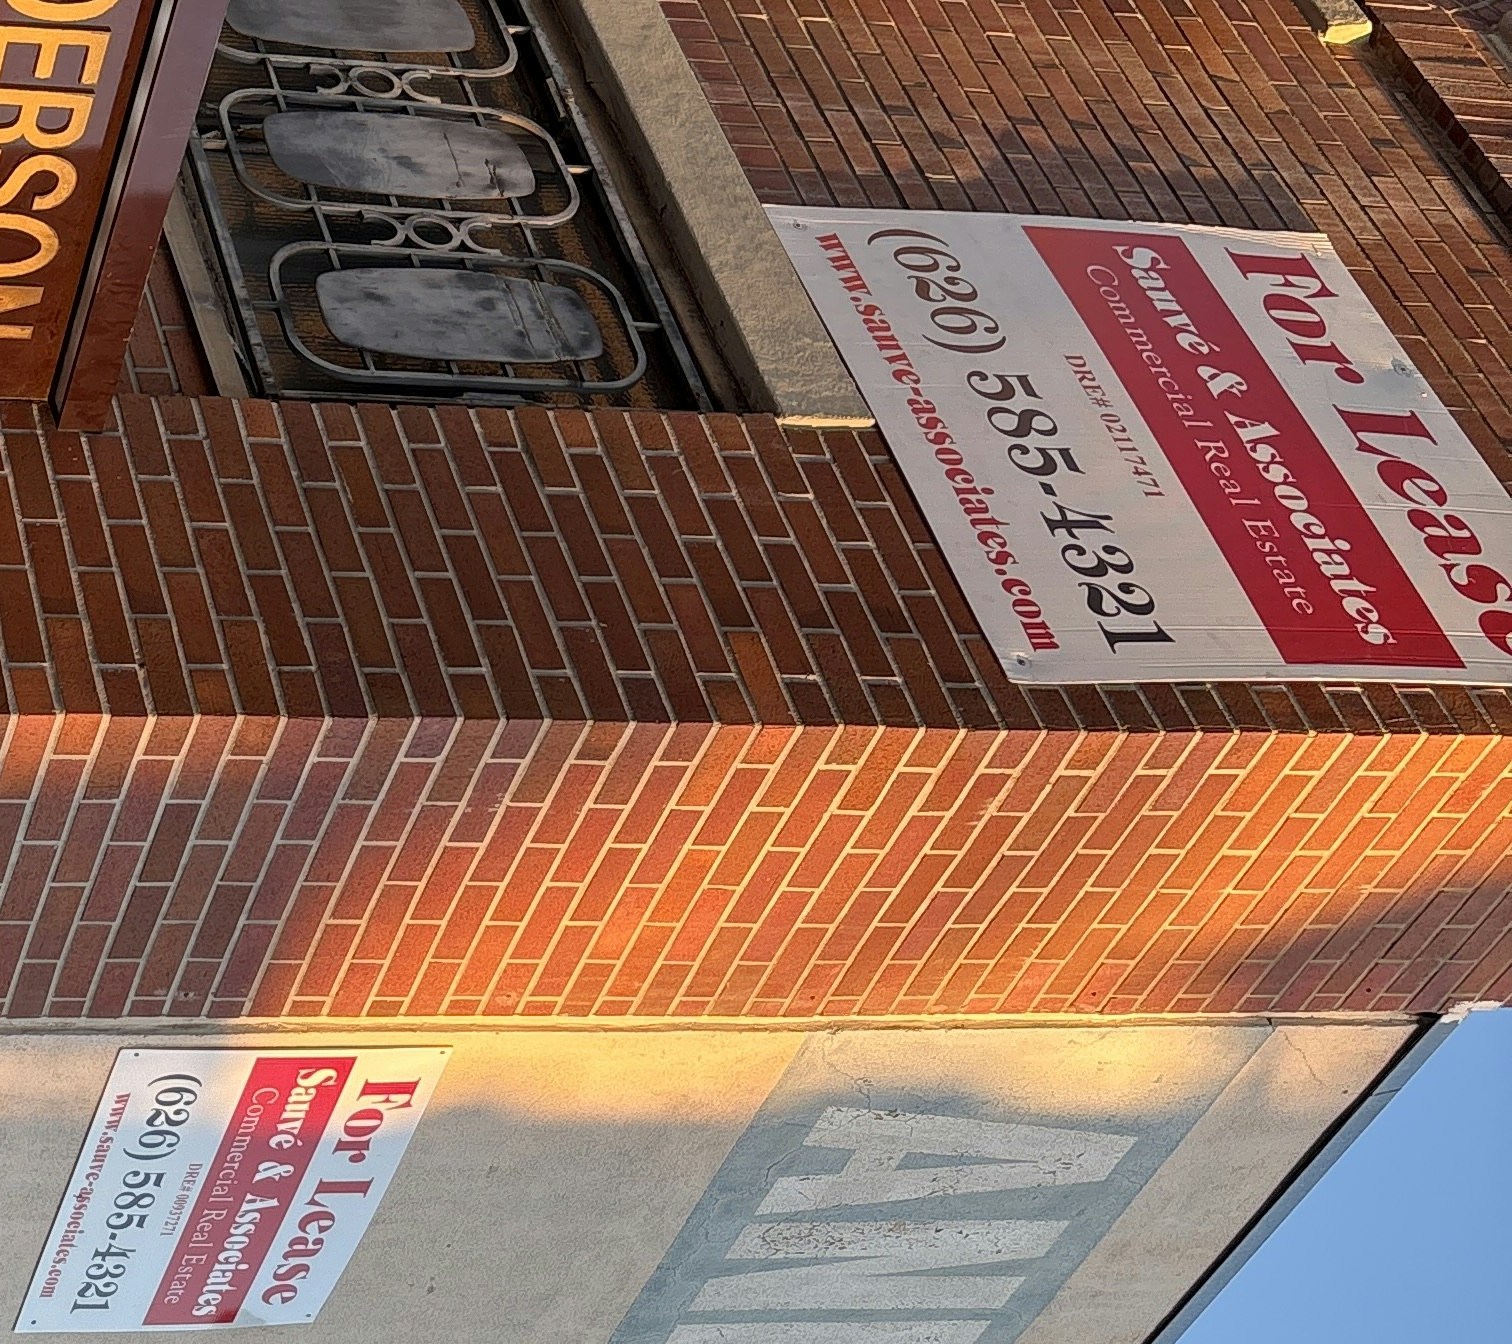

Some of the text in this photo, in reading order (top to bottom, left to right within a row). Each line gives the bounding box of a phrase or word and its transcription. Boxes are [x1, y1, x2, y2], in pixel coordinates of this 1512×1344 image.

[1064, 354, 1165, 500] DRE# 02117471
[1225, 247, 1365, 383] For
[814, 232, 1060, 652] www.sauve-associates.com
[866, 226, 1175, 655] (626) 585-4321
[1086, 265, 1317, 616] Commercial Real Estate
[1111, 244, 1399, 646] Sauvé & Associates
[39, 1093, 131, 1299] www.sauve-associates.com
[69, 1074, 203, 1314] (626) 585-4321
[160, 1163, 203, 1237] DRE# 00937271
[163, 1087, 279, 1304] Commercial Real Estate
[191, 1068, 339, 1316] Sauvé & Associates
[261, 1077, 421, 1306] For Lease
